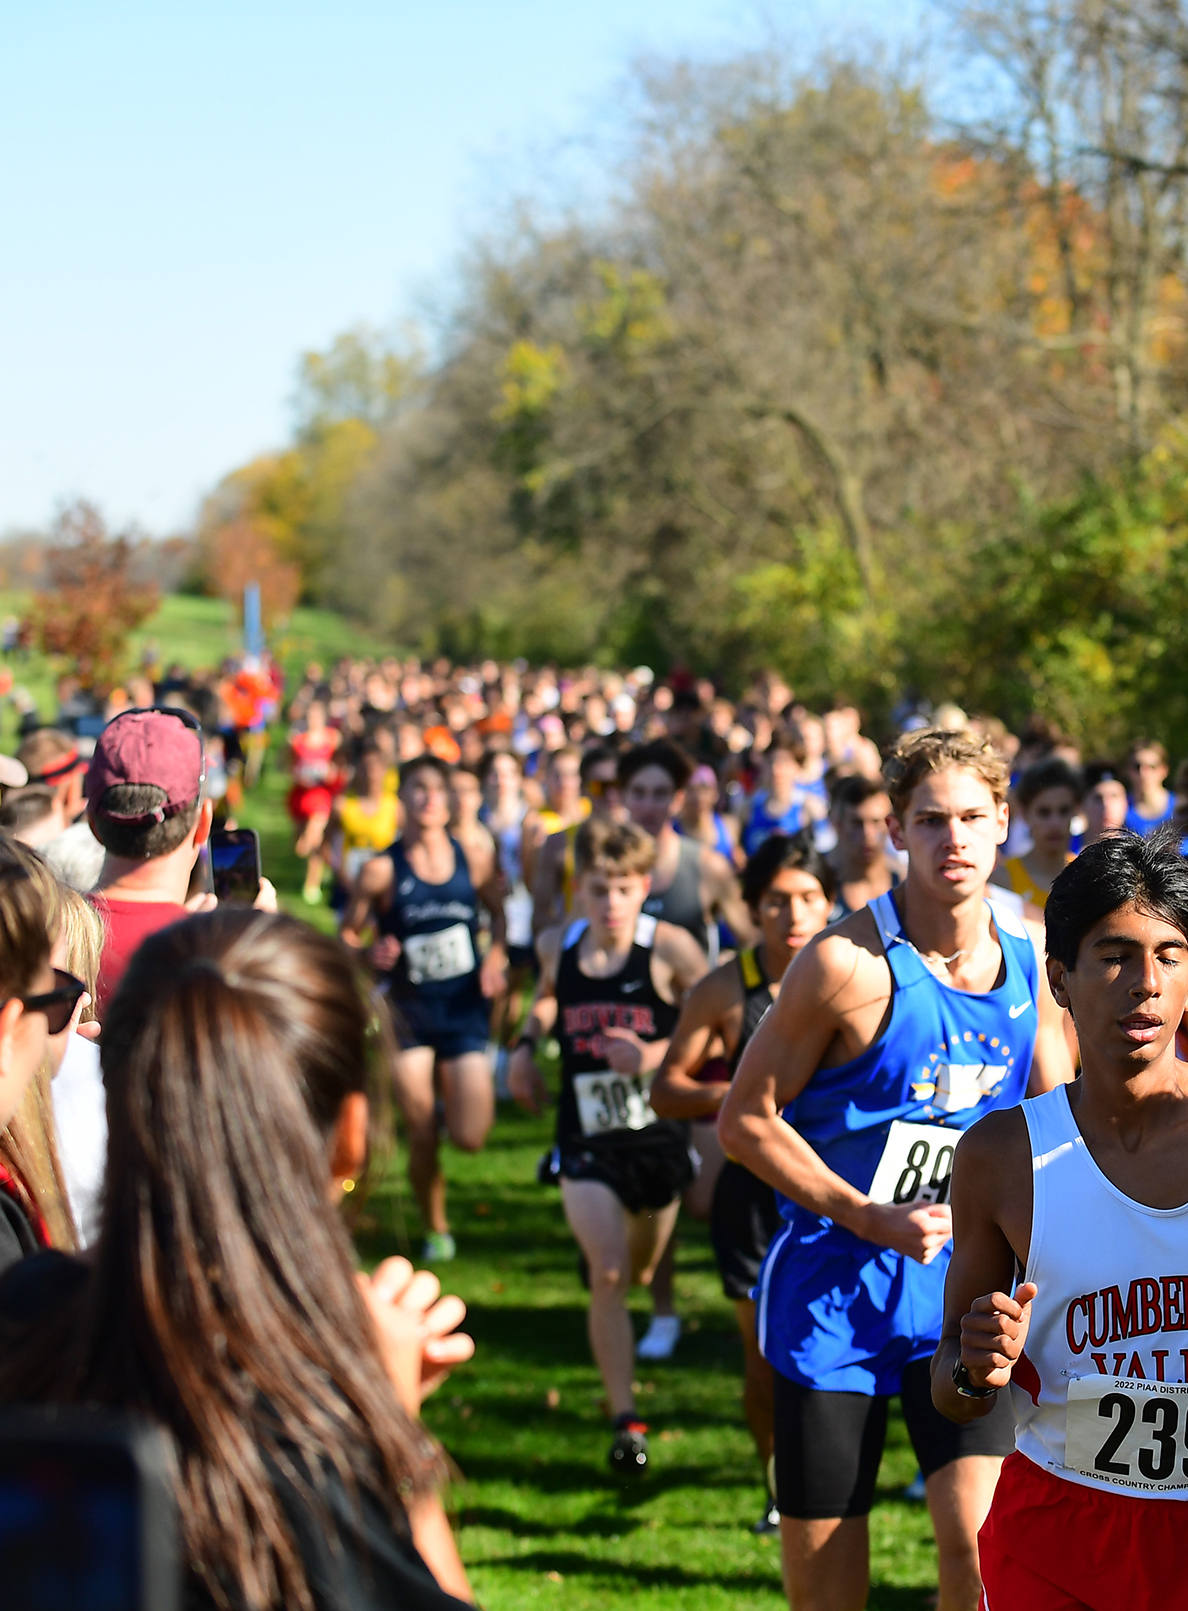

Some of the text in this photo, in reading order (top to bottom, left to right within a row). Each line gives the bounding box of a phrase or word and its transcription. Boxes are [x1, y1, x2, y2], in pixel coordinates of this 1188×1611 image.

[1114, 1380, 1135, 1390] 2022
[1136, 1383, 1157, 1393] PIAA
[1080, 1470, 1110, 1482] CROSS
[1112, 1477, 1156, 1491] COUNTRY
